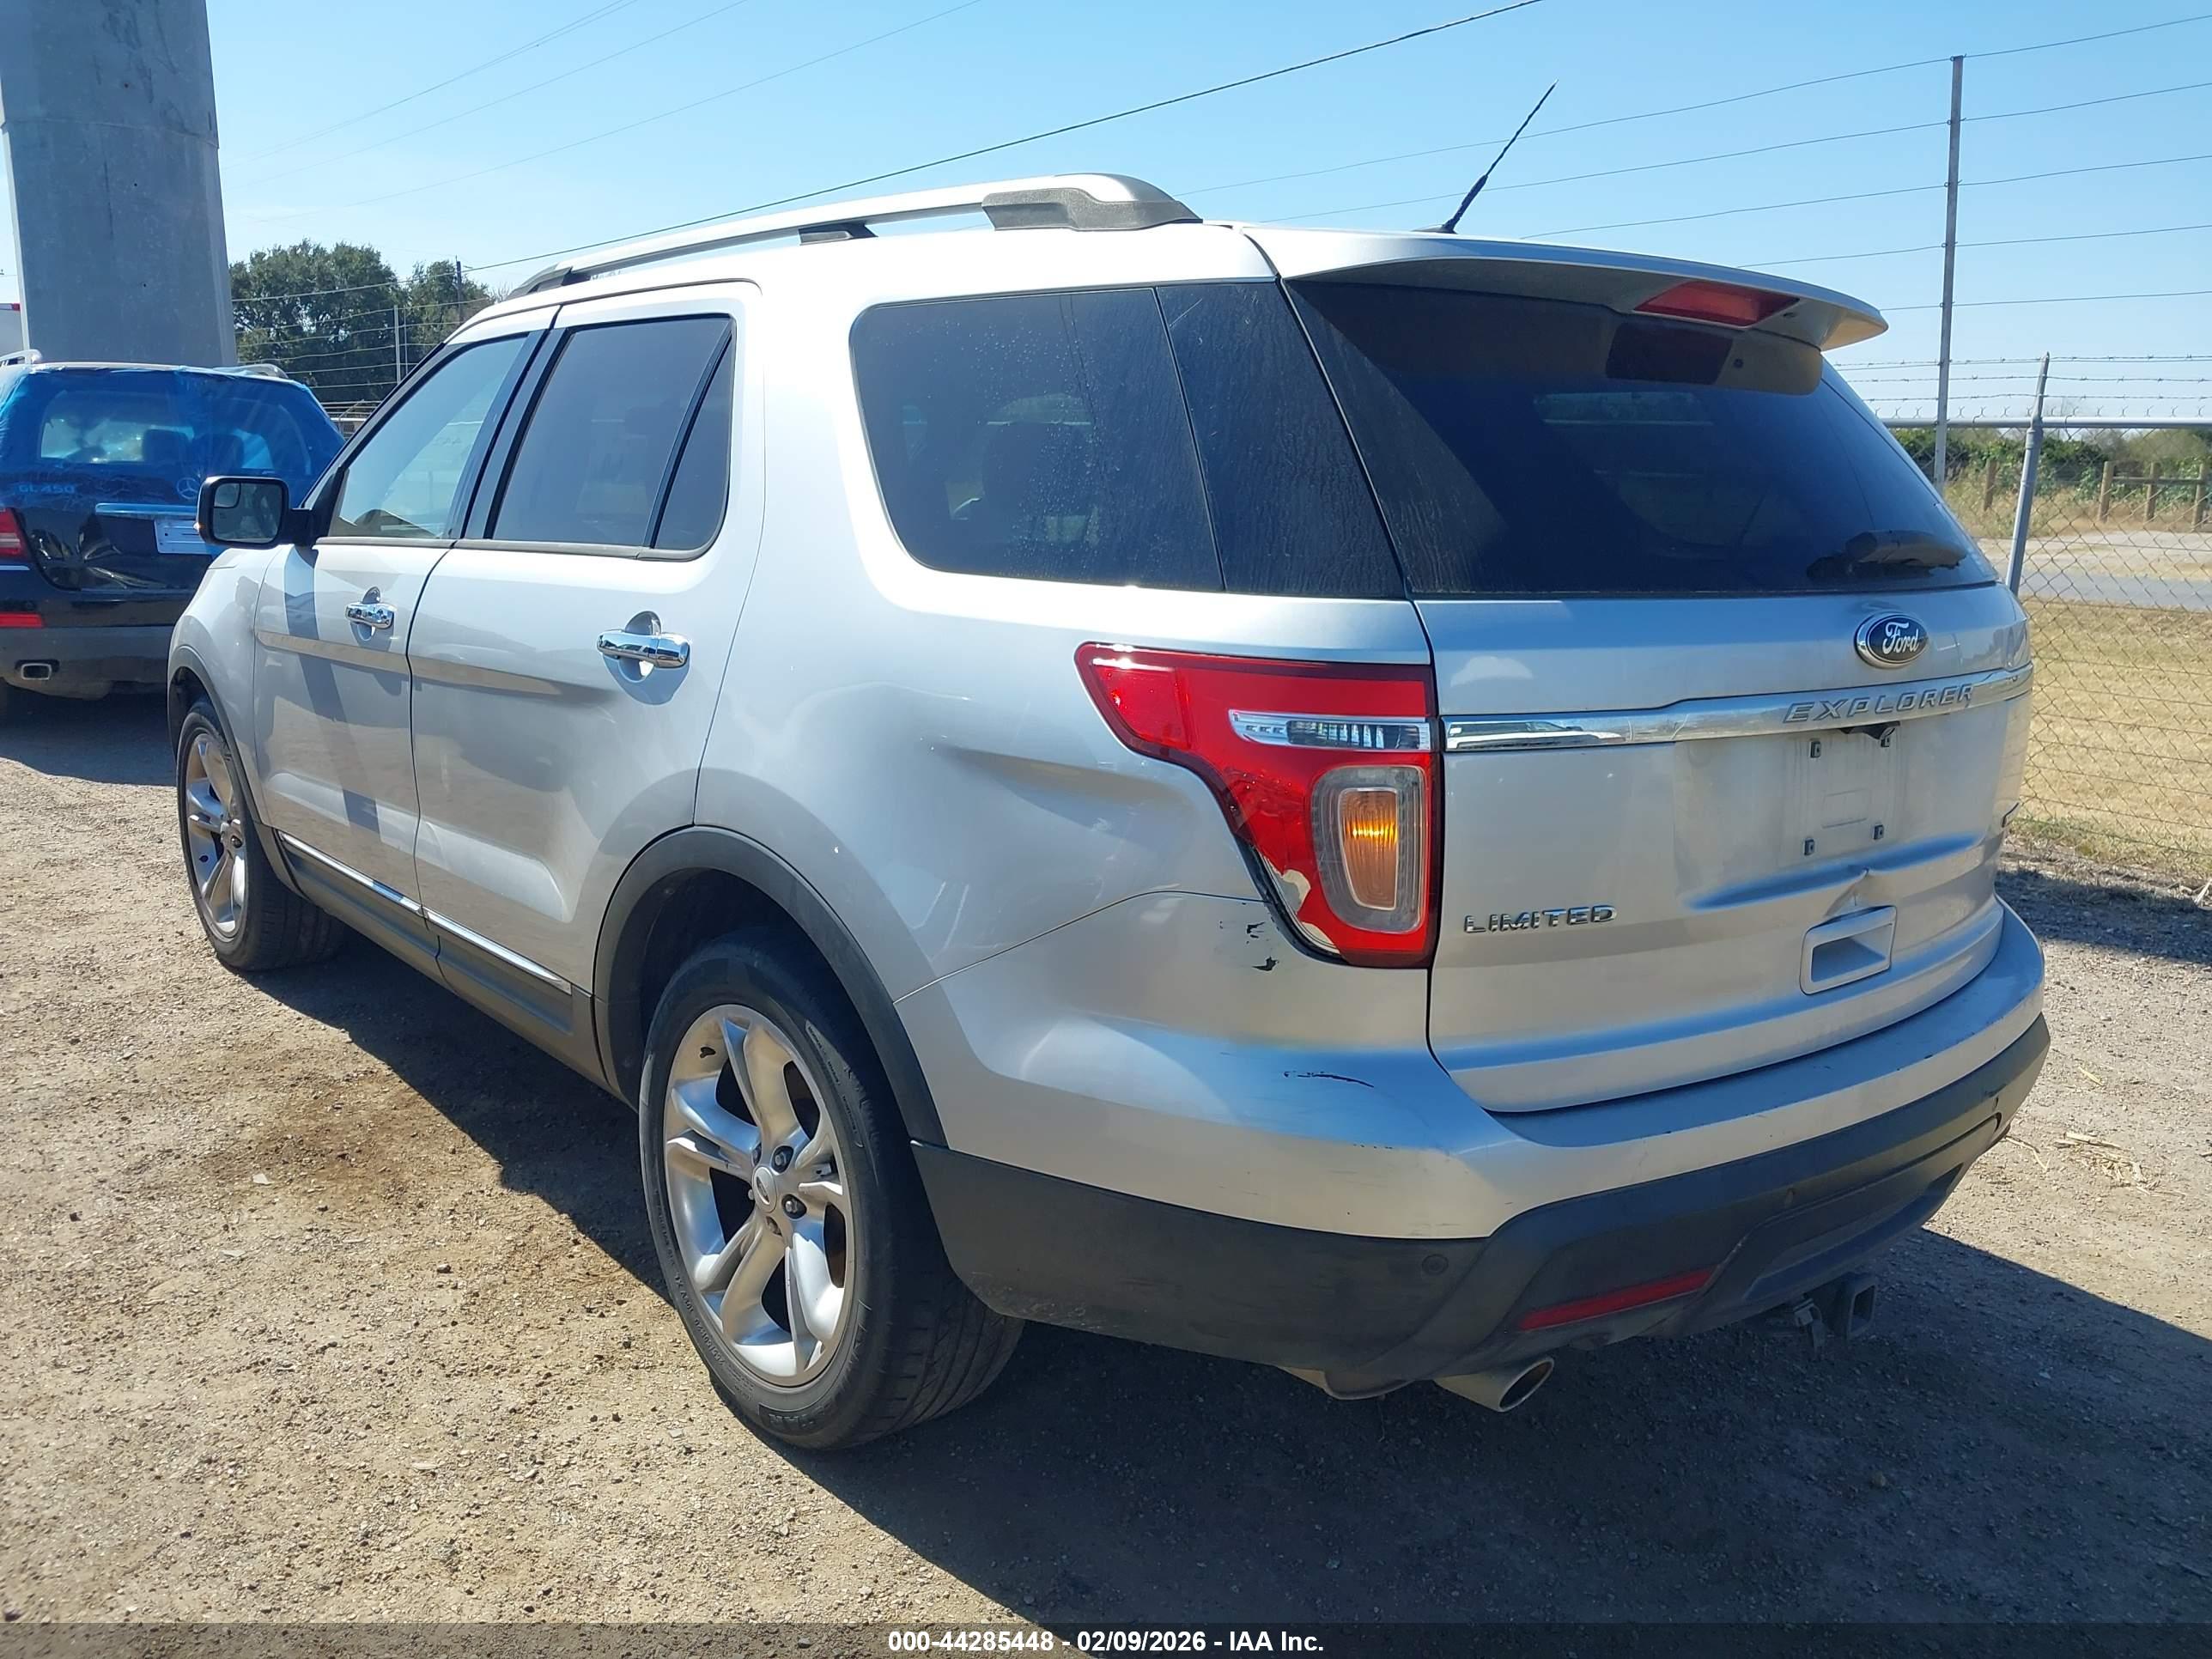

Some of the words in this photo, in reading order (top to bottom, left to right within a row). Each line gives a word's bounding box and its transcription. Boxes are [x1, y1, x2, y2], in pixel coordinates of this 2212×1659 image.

[1882, 622, 1920, 655] Ford
[1783, 684, 1975, 724] EXPLORER
[1463, 904, 1618, 933] LIMITED
